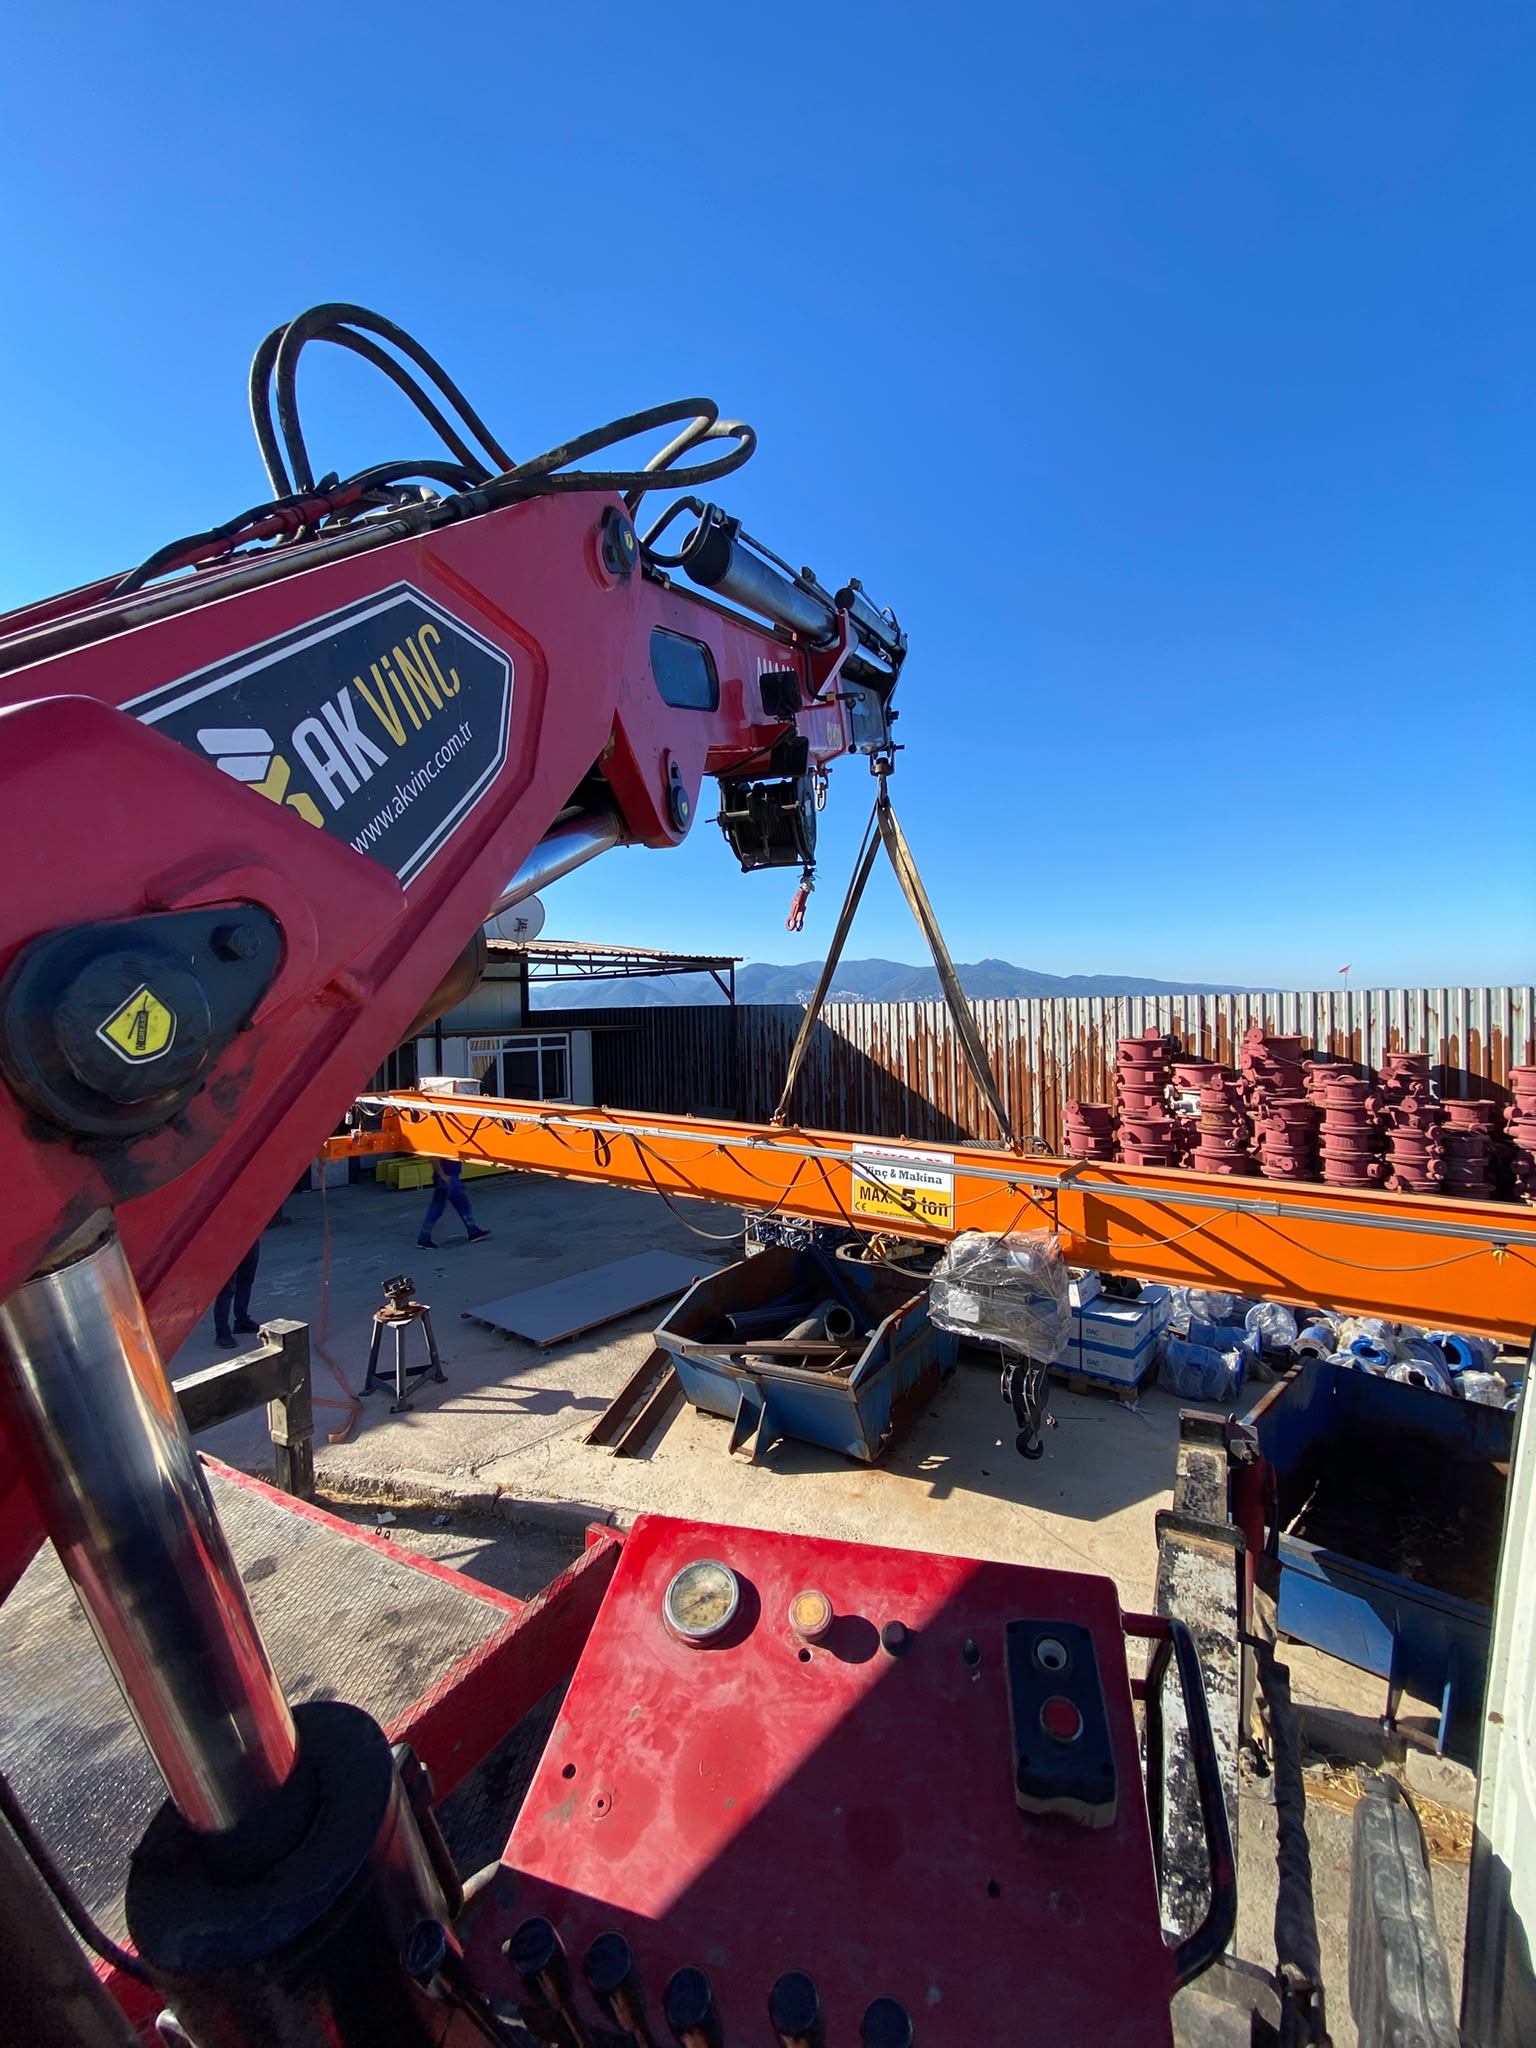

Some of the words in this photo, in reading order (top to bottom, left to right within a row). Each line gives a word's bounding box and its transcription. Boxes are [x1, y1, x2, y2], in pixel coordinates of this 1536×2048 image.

[890, 1168, 897, 1179] &
[899, 1170, 943, 1185] Makina
[860, 1186, 893, 1204] MAX.
[901, 1188, 917, 1212] 5
[921, 1197, 948, 1217] ton
